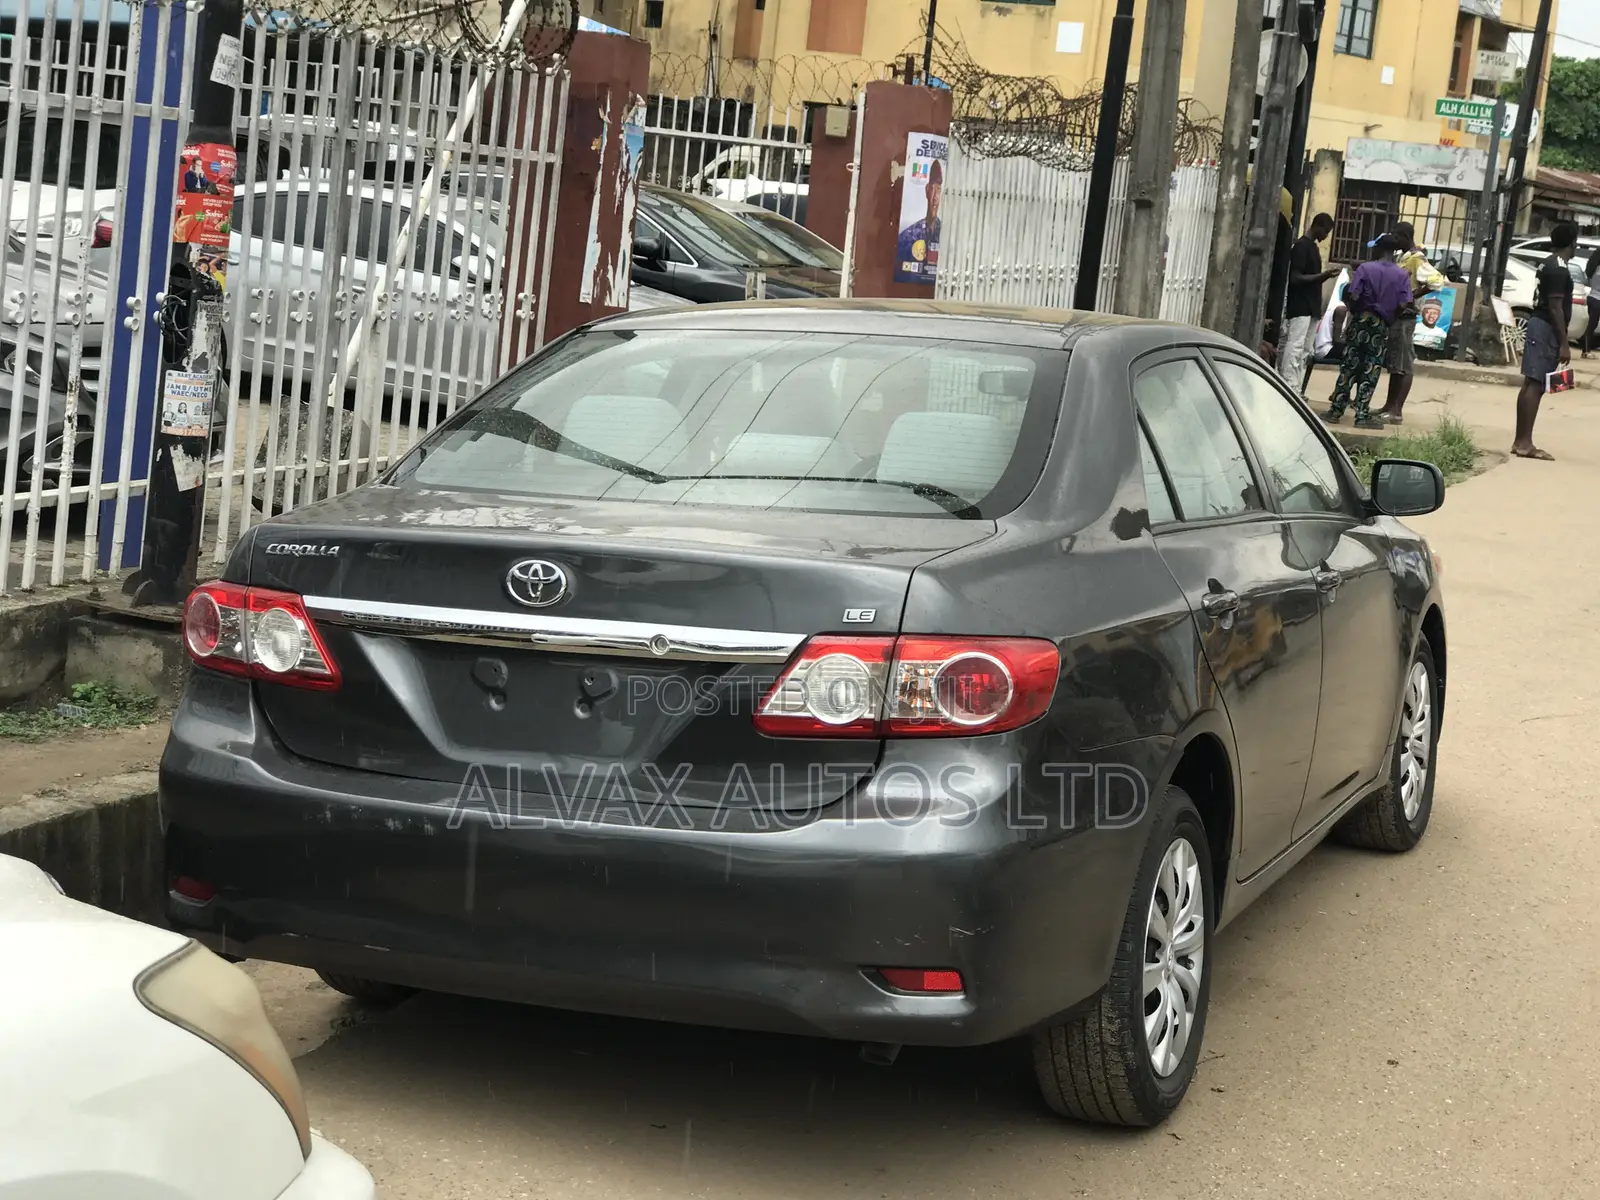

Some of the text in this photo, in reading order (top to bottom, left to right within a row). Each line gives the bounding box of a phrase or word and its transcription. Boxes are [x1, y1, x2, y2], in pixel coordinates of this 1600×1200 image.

[1439, 102, 1493, 118] ALH ALLI LN
[171, 390, 208, 398] WAEC/NECO
[265, 542, 341, 557] COROLLA
[844, 609, 875, 622] LE
